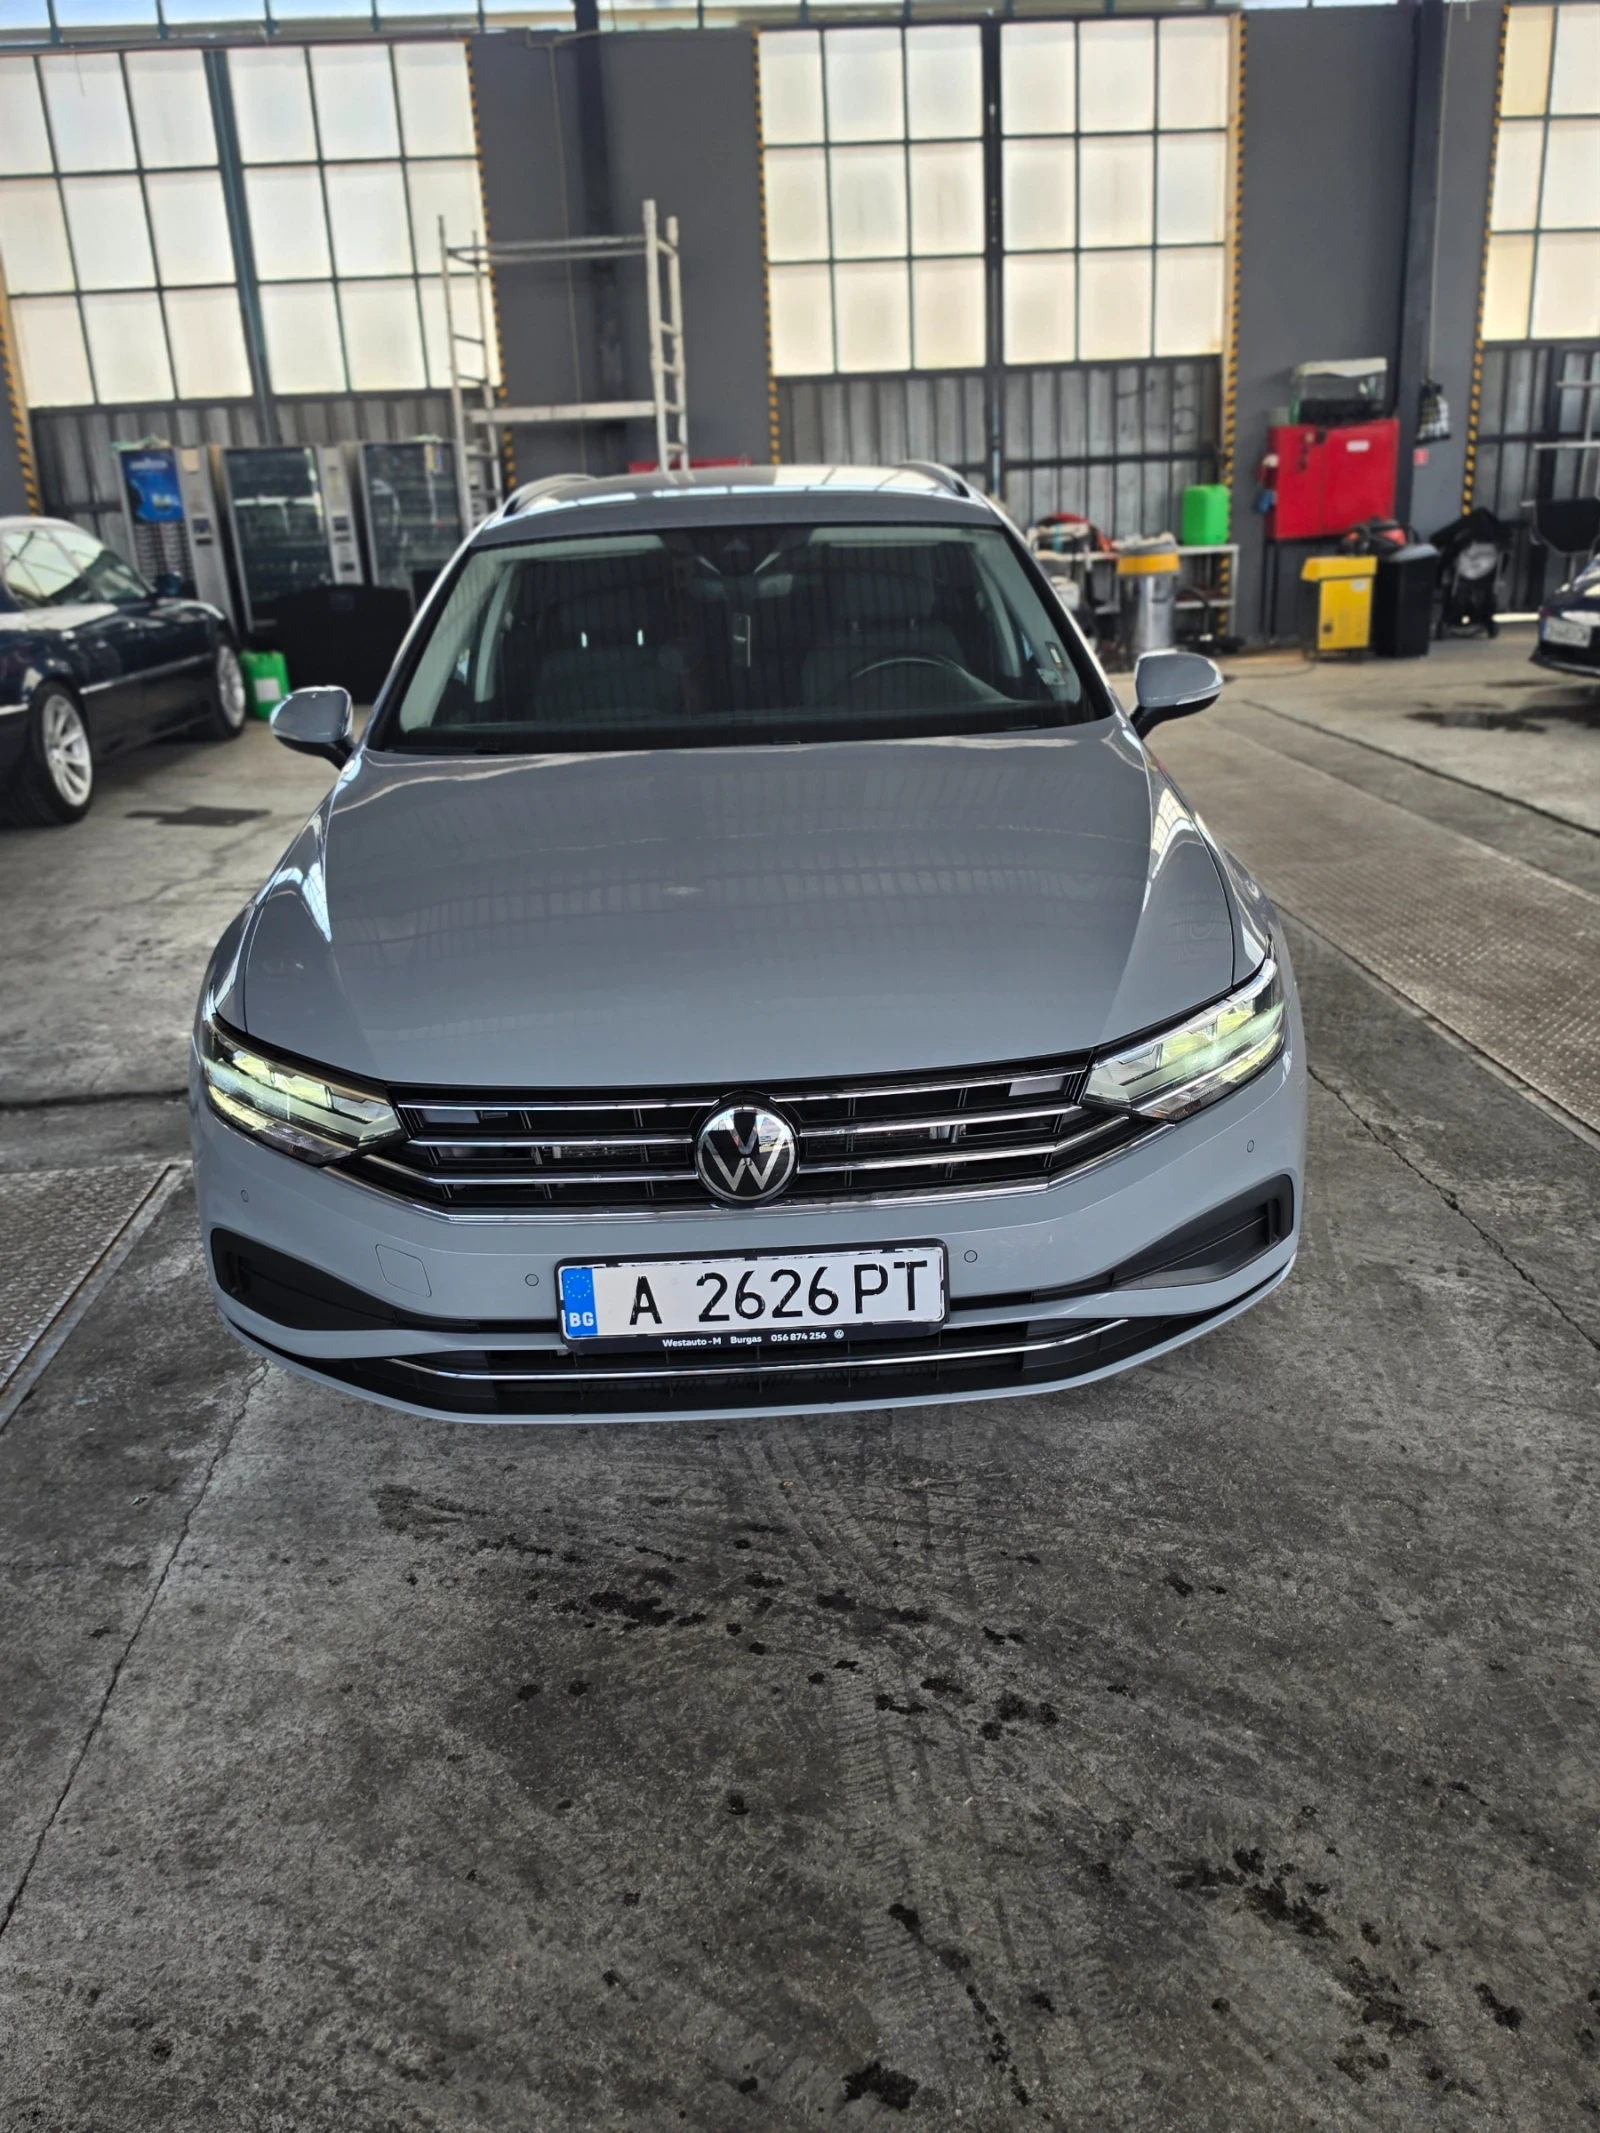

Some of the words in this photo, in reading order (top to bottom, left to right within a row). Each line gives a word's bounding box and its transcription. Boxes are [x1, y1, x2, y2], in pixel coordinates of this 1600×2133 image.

[629, 1275, 663, 1325] A
[696, 1266, 839, 1323] 2626
[853, 1260, 928, 1314] PT
[569, 1312, 595, 1328] BG
[730, 1335, 762, 1345] Burgas
[771, 1333, 788, 1342] 056
[790, 1332, 808, 1341] 874
[809, 1331, 827, 1340] 256
